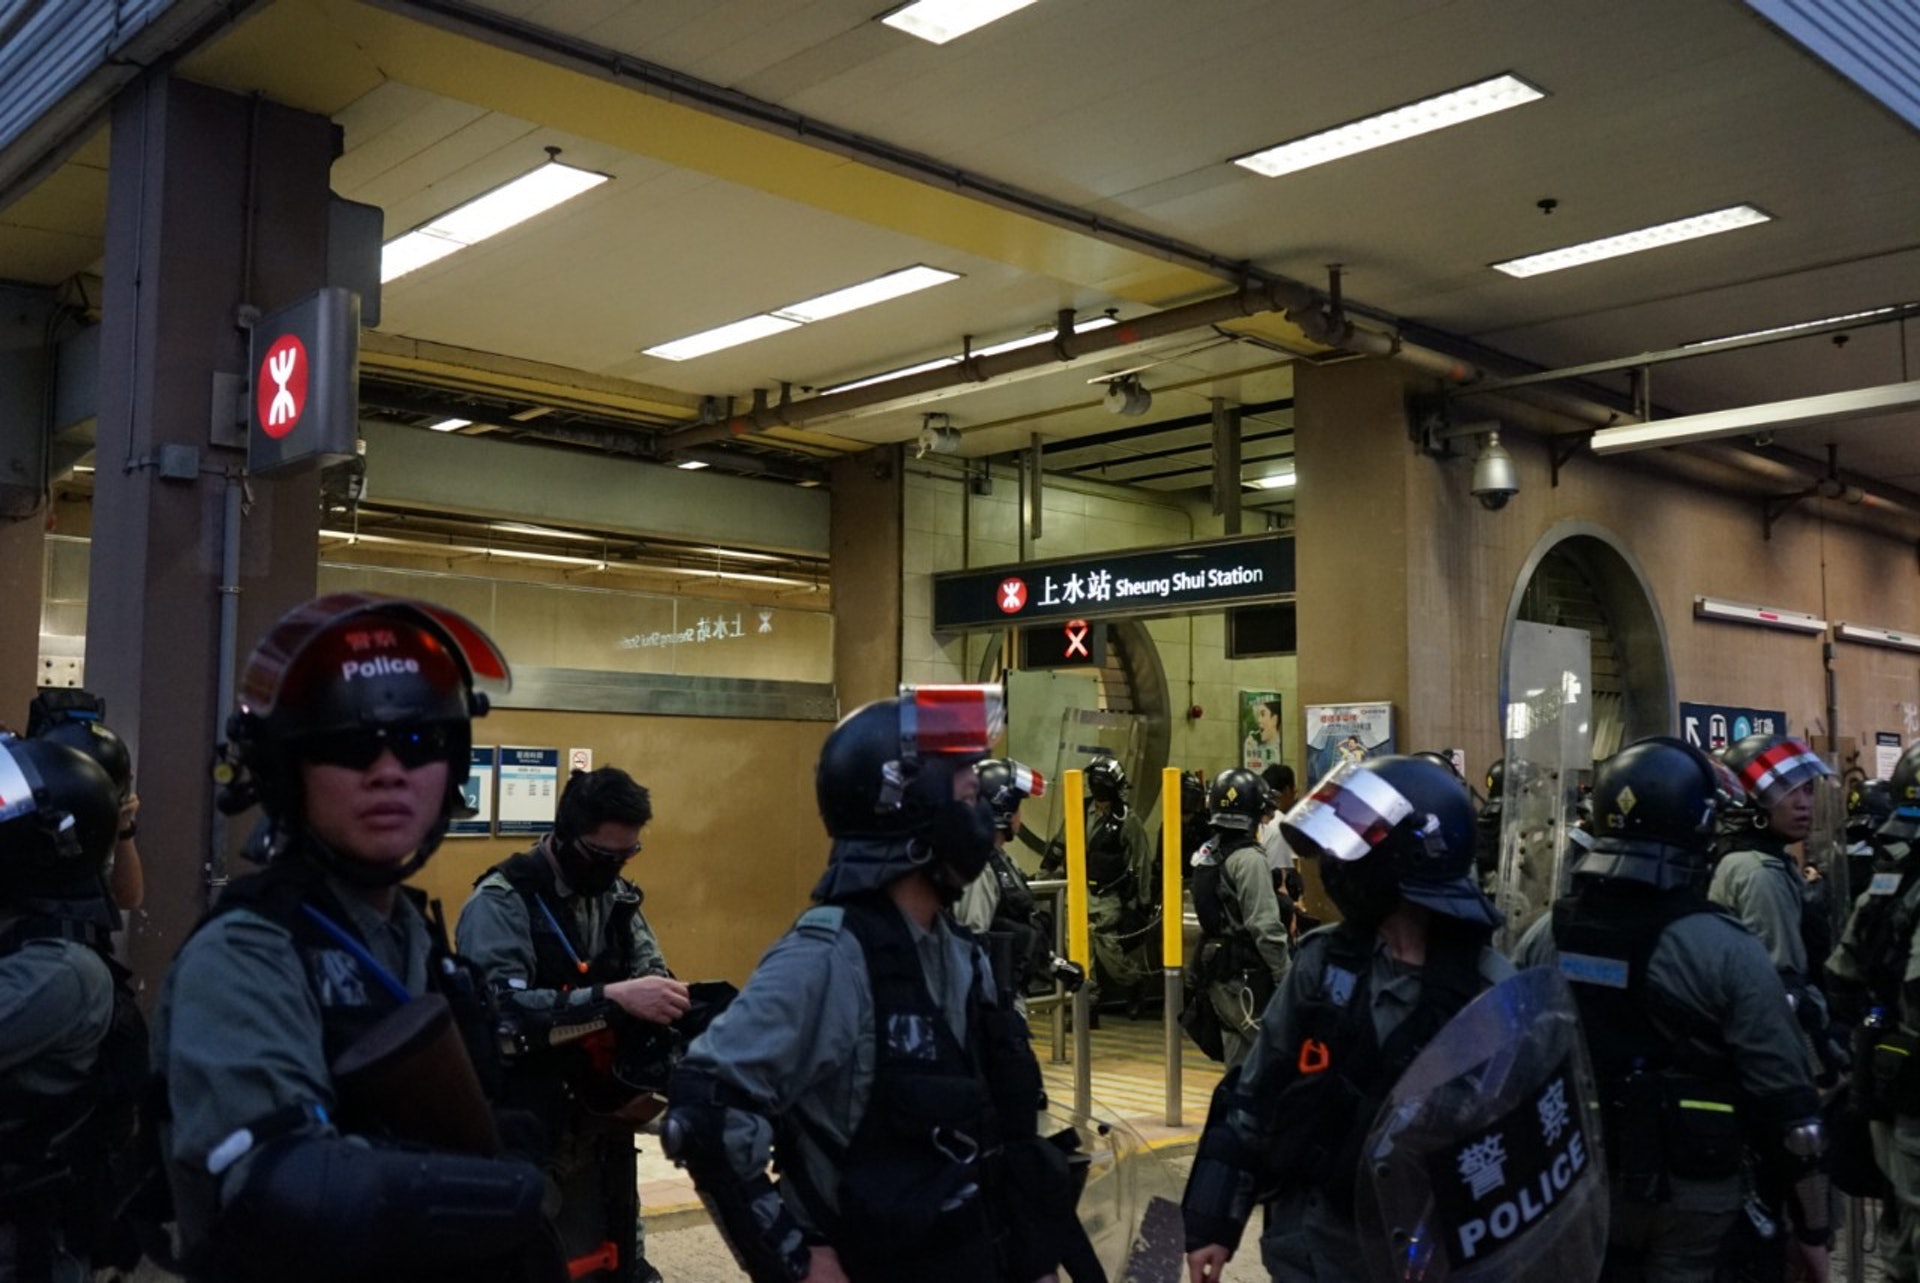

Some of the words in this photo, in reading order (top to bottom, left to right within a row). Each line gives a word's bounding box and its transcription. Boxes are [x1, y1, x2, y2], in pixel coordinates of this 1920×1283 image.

[1037, 569, 1112, 606] 上水站
[1115, 578, 1170, 598] Sheung
[1172, 570, 1205, 591] Shui
[1208, 565, 1264, 587] Station
[341, 655, 420, 683] Police
[1458, 1129, 1586, 1259] POLICE
